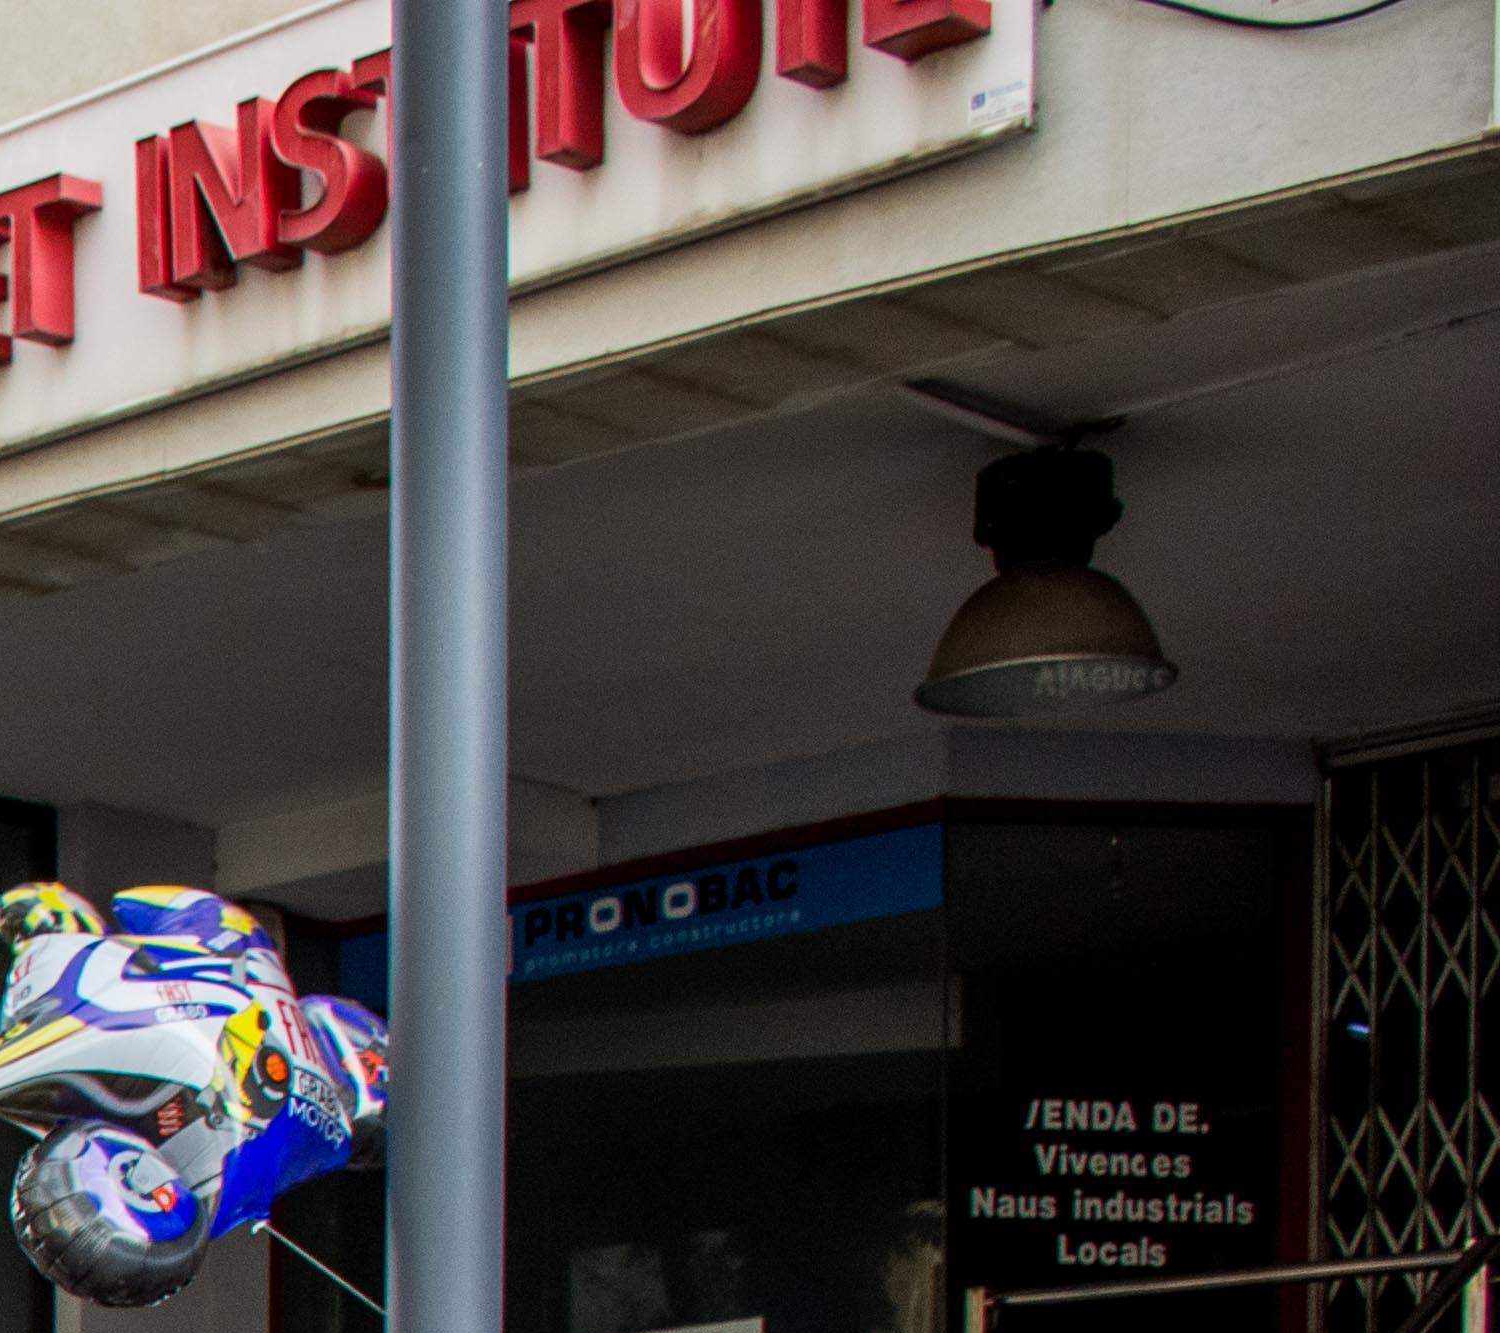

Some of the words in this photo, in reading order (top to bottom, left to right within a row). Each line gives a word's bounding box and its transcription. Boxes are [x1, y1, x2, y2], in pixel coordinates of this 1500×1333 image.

[135, 0, 991, 304] INSTU
[525, 862, 798, 947] PRONOBAC
[969, 1186, 1058, 1219] Naus
[1071, 1189, 1257, 1226] industrials
[1055, 1233, 1167, 1267] Locals
